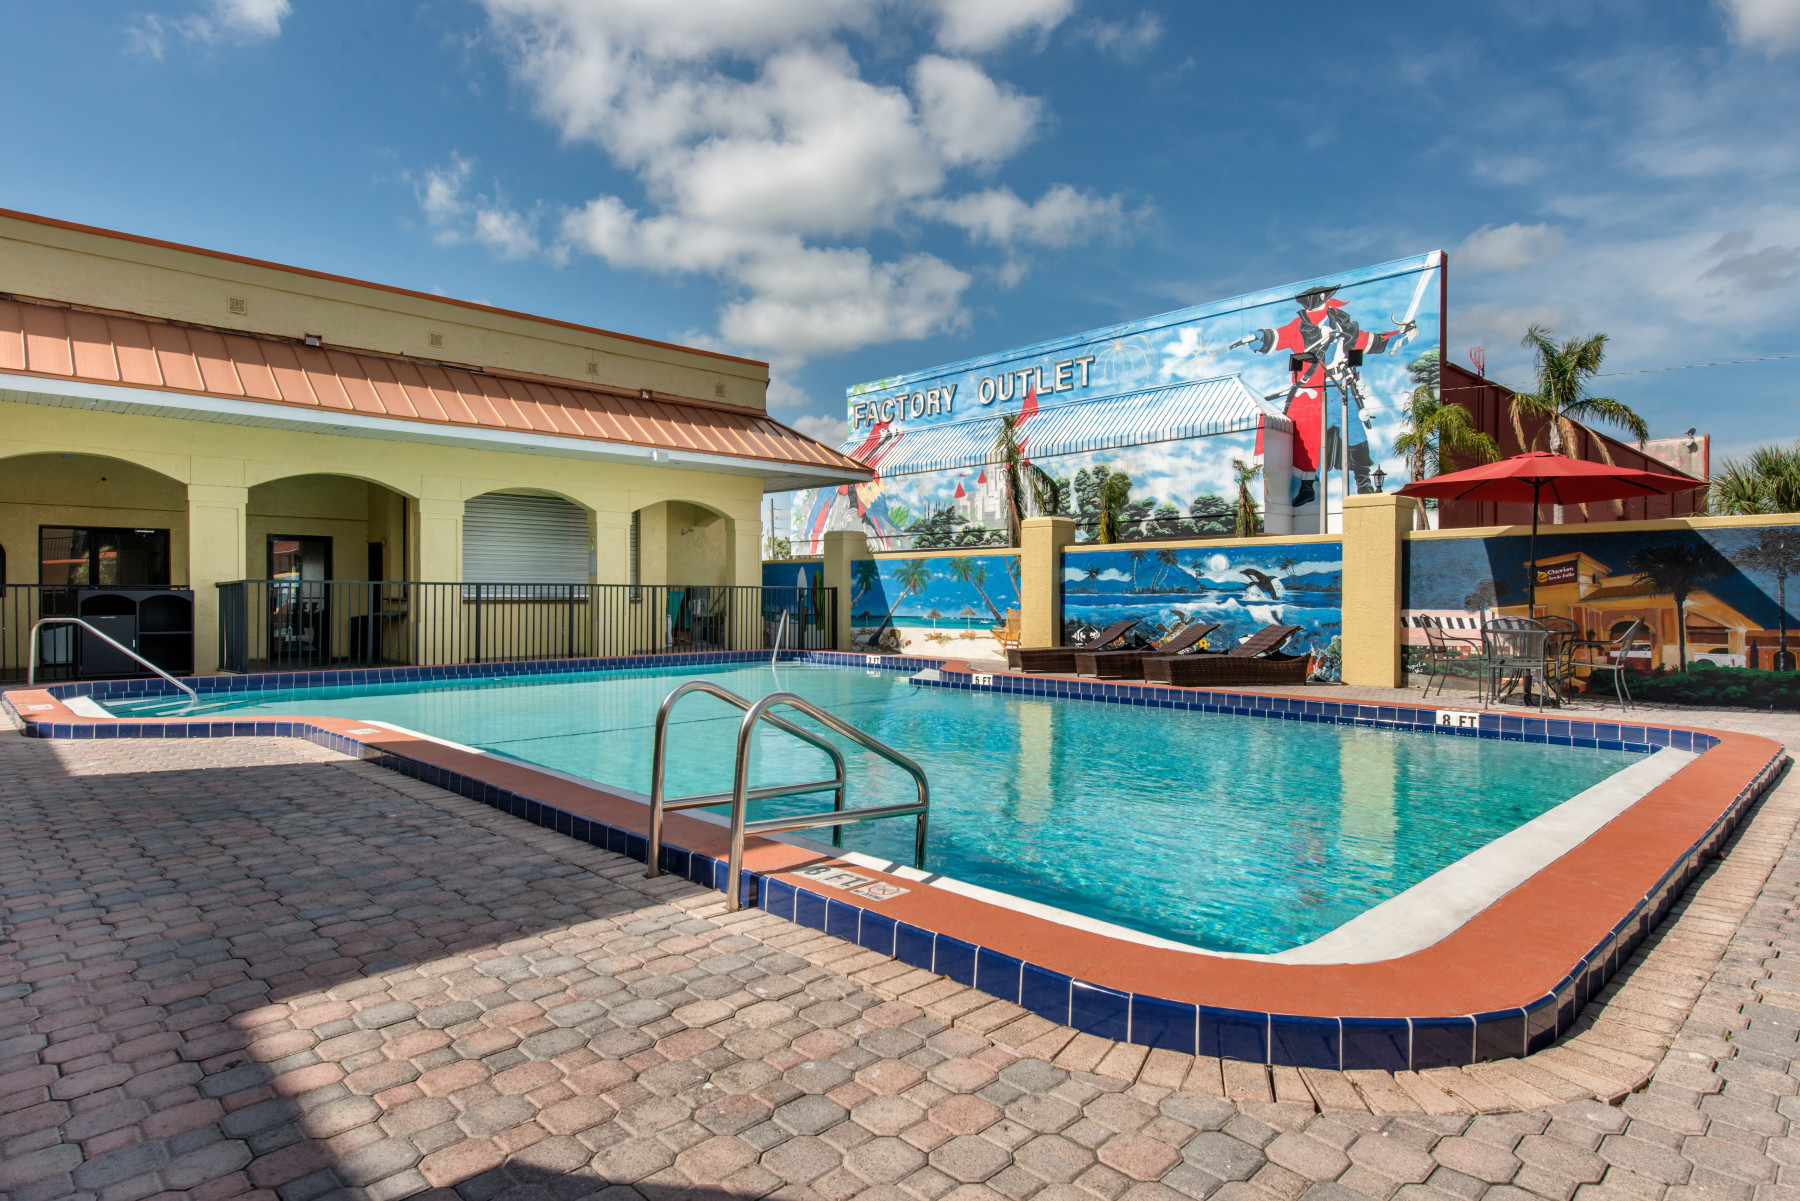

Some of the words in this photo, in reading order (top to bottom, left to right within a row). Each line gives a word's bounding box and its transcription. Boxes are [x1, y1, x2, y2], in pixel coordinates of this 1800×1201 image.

[852, 384, 957, 429] FACTORY
[977, 355, 1095, 405] OUTLET
[873, 657, 880, 665] FT
[975, 676, 980, 684] 5
[983, 677, 992, 685] FT
[1442, 714, 1451, 725] 8
[1459, 715, 1476, 728] FT
[804, 866, 831, 875] 8
